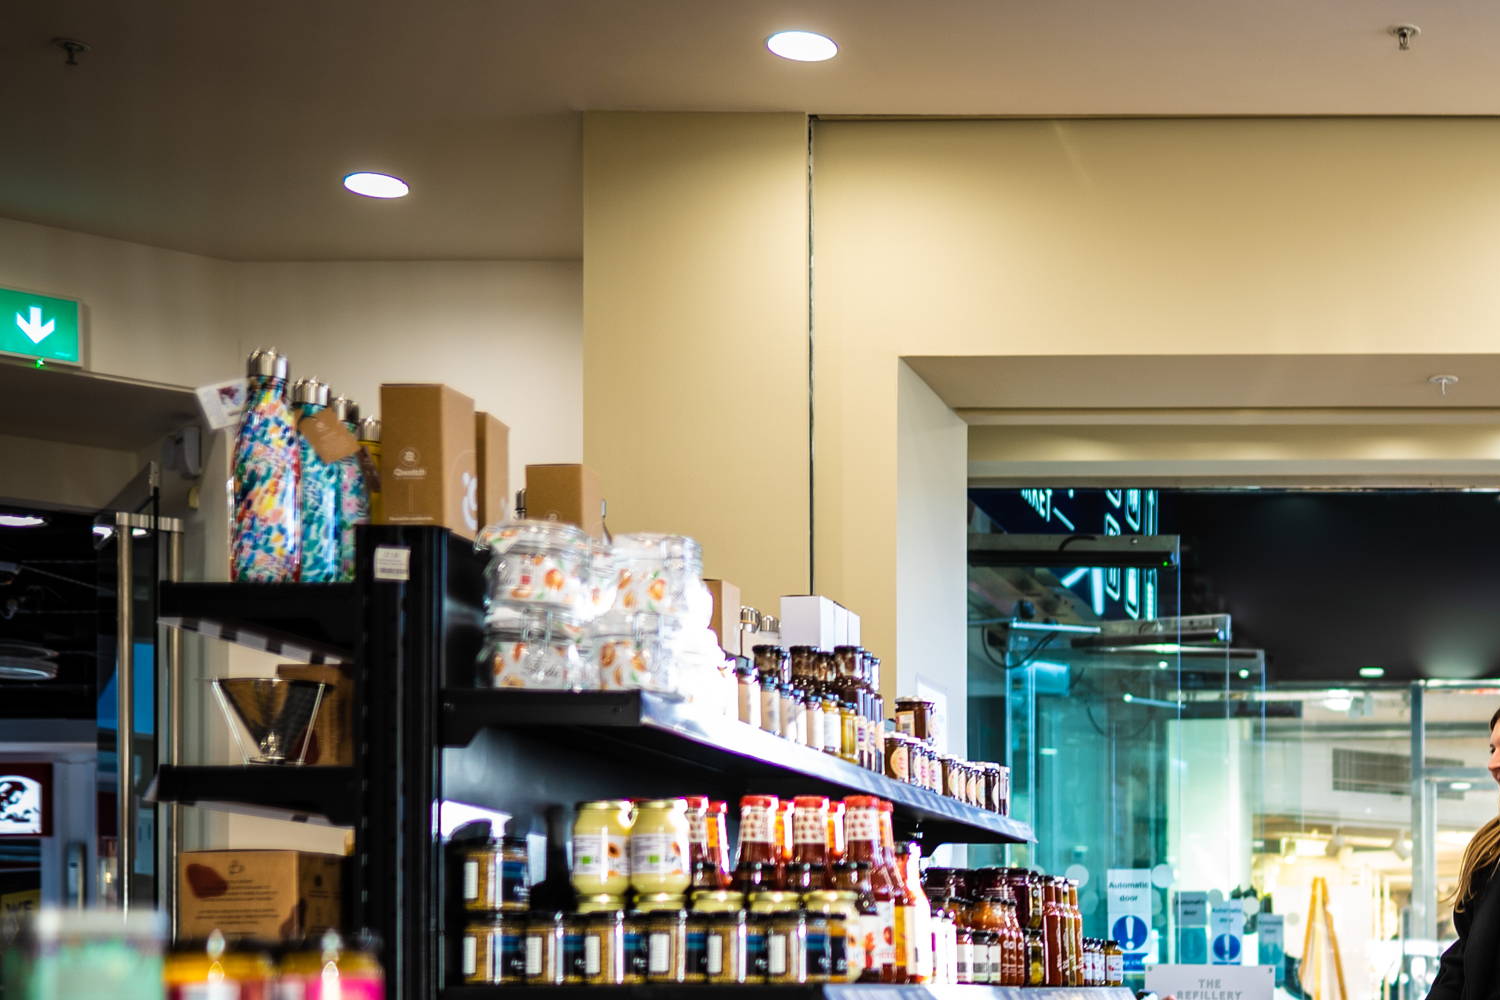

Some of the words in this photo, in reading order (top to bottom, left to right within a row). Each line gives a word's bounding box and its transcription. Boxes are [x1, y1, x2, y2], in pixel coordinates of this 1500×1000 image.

[1119, 894, 1138, 902] door
[1198, 978, 1222, 989] THE
[1176, 990, 1243, 1000] REFILLERY
